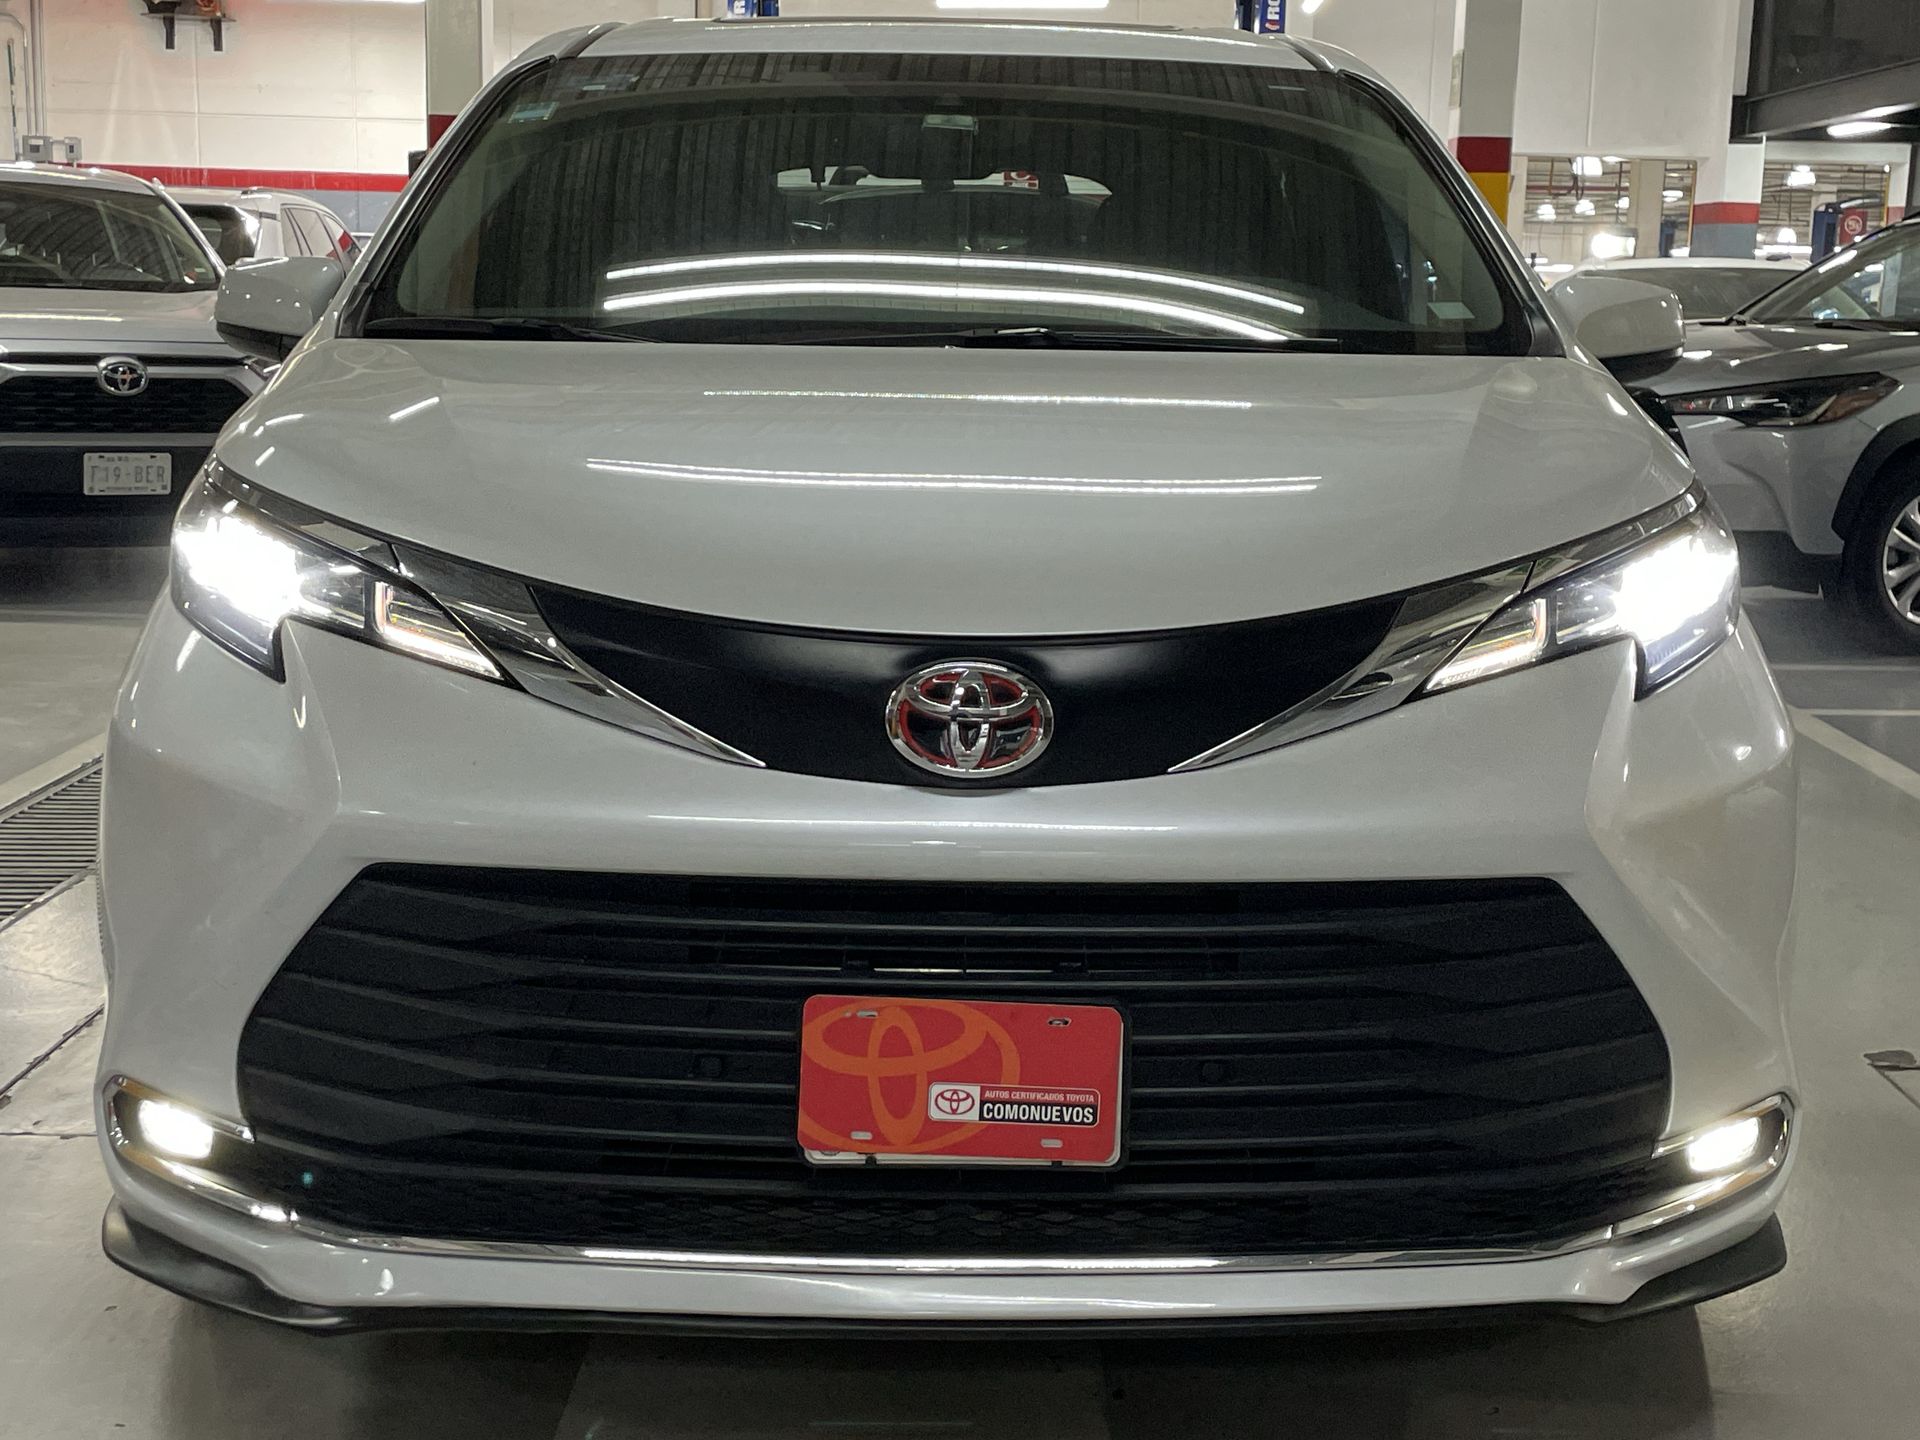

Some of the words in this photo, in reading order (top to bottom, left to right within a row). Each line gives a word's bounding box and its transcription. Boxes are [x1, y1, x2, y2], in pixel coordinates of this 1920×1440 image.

[984, 1090, 1010, 1099] AUTOS
[1011, 1091, 1065, 1101] CERTIFICADOS
[1066, 1093, 1094, 1102] TOYOTA
[983, 1102, 1094, 1123] COMONUEVOS
